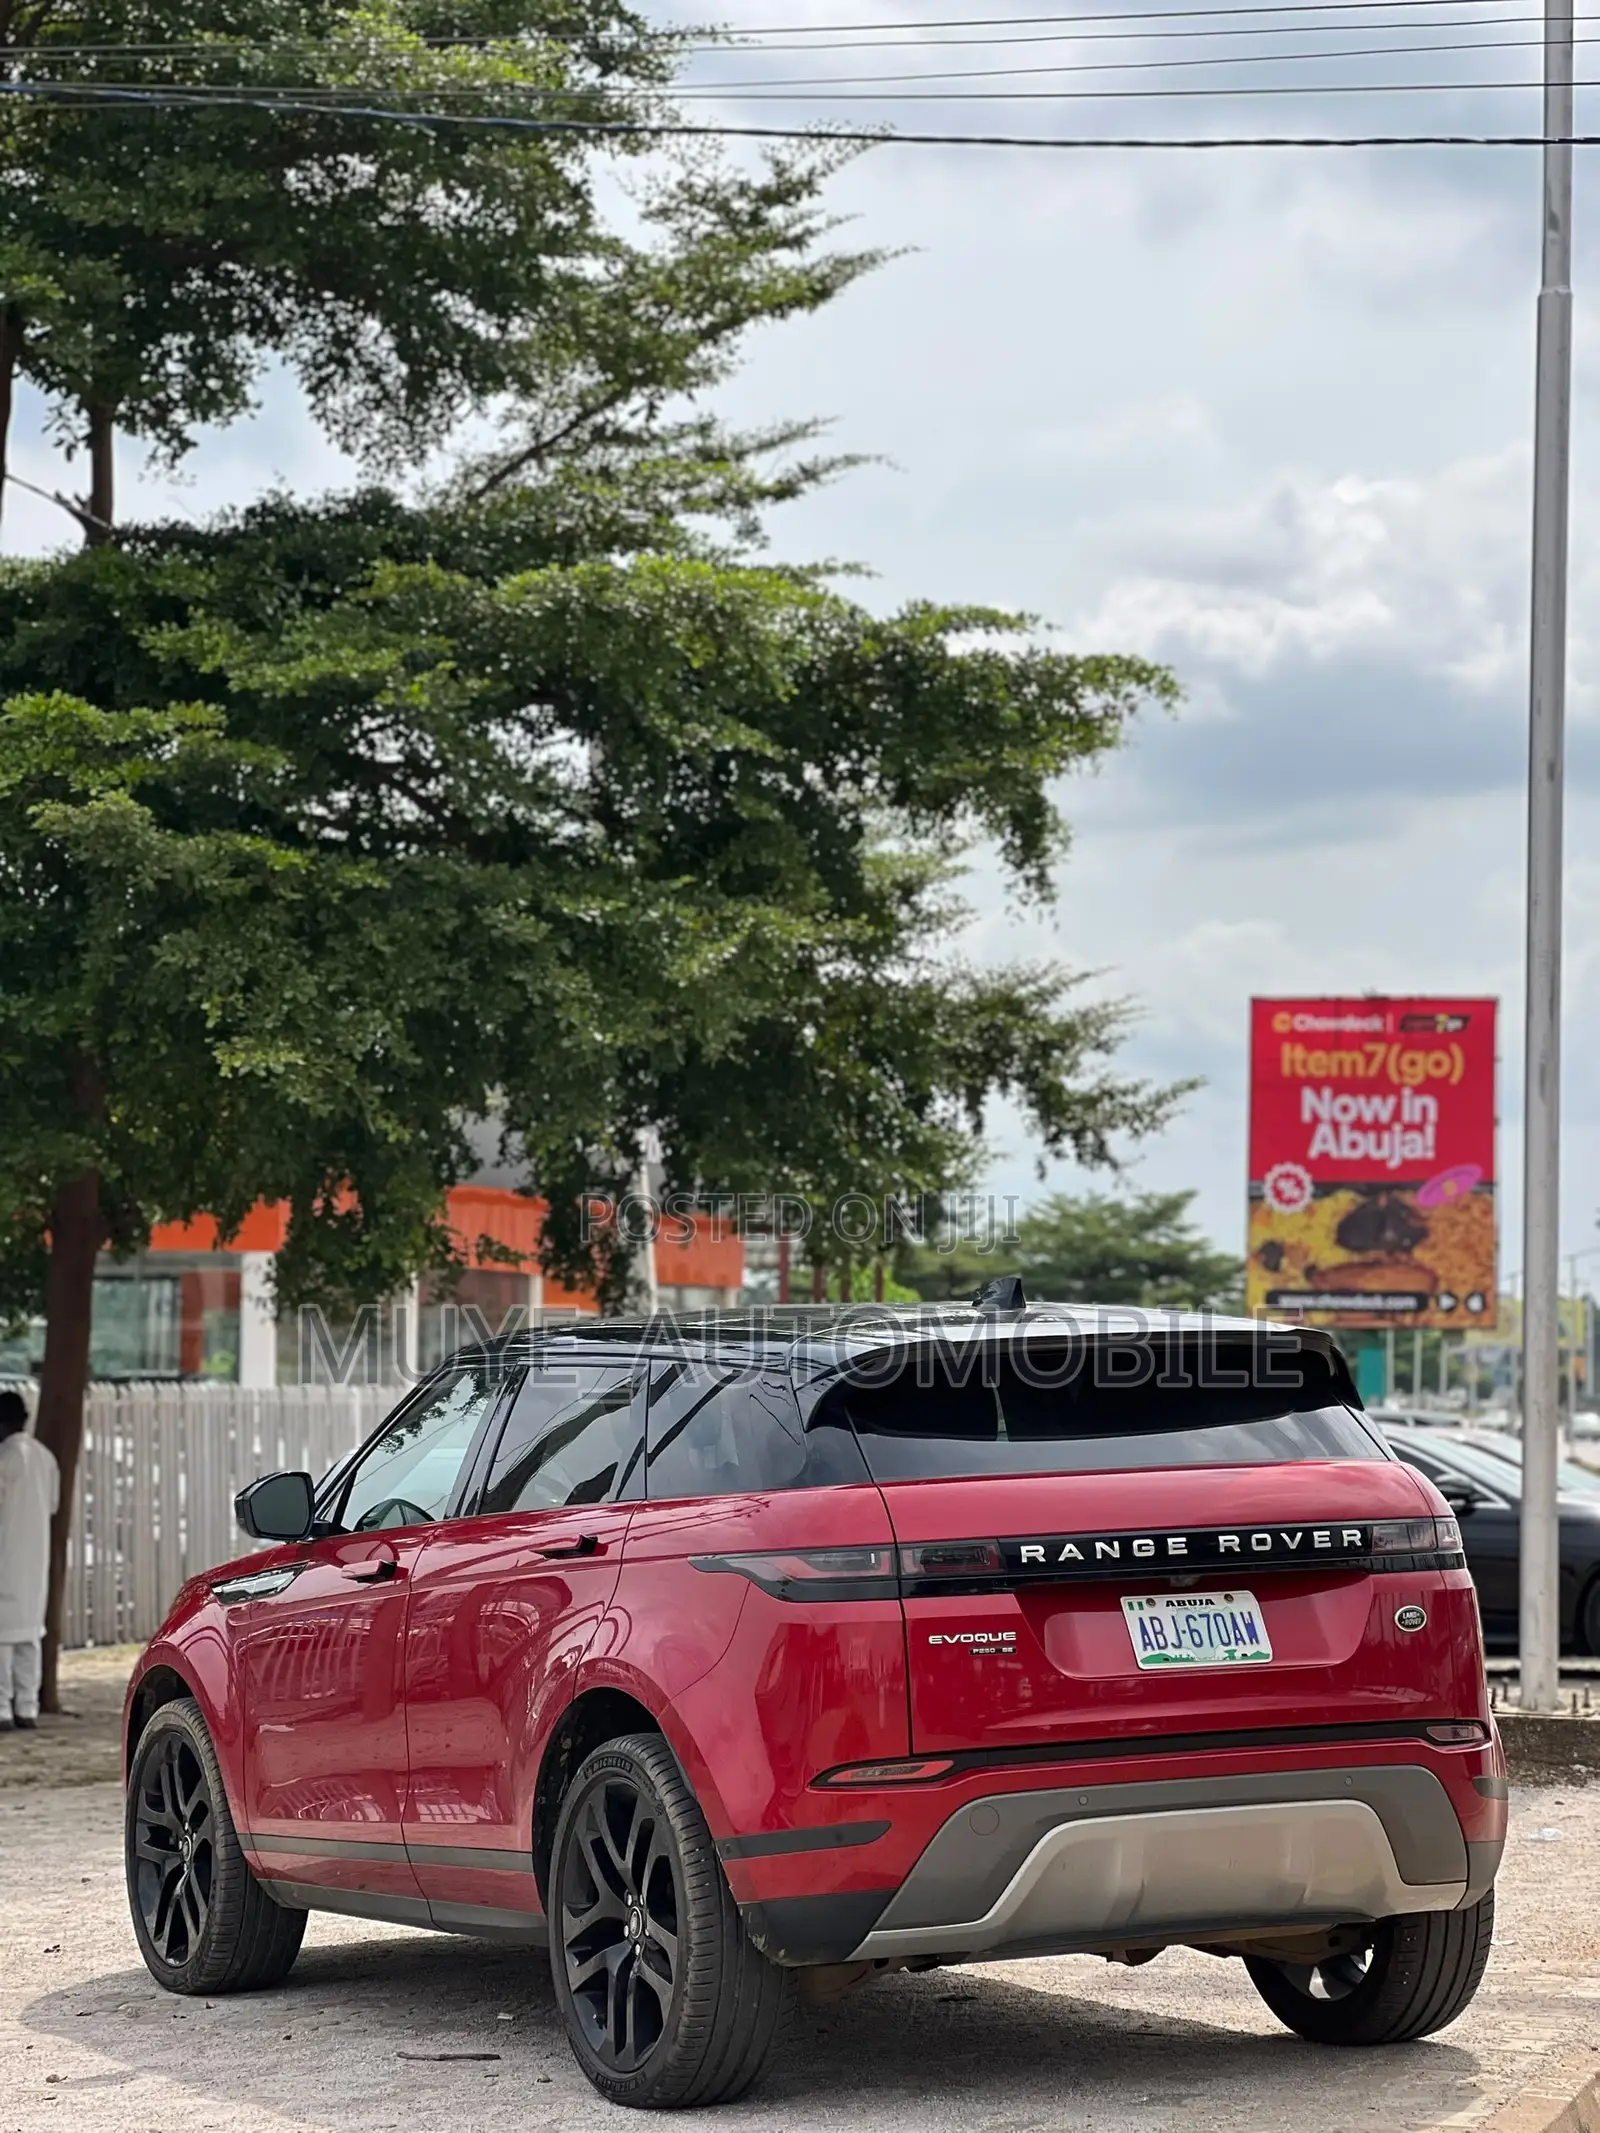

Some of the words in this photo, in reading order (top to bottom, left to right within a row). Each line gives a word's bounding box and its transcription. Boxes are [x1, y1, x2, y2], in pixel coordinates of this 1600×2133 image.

[1280, 1041, 1464, 1086] Item7(go)
[1300, 1086, 1397, 1124] Now
[1401, 1086, 1438, 1124] in
[1307, 1122, 1436, 1169] Abuja!
[1020, 1536, 1188, 1563] RANGE
[1218, 1529, 1363, 1553] ROVER
[1165, 1598, 1215, 1608] ABUJA
[928, 1631, 1016, 1645] EVOQUE
